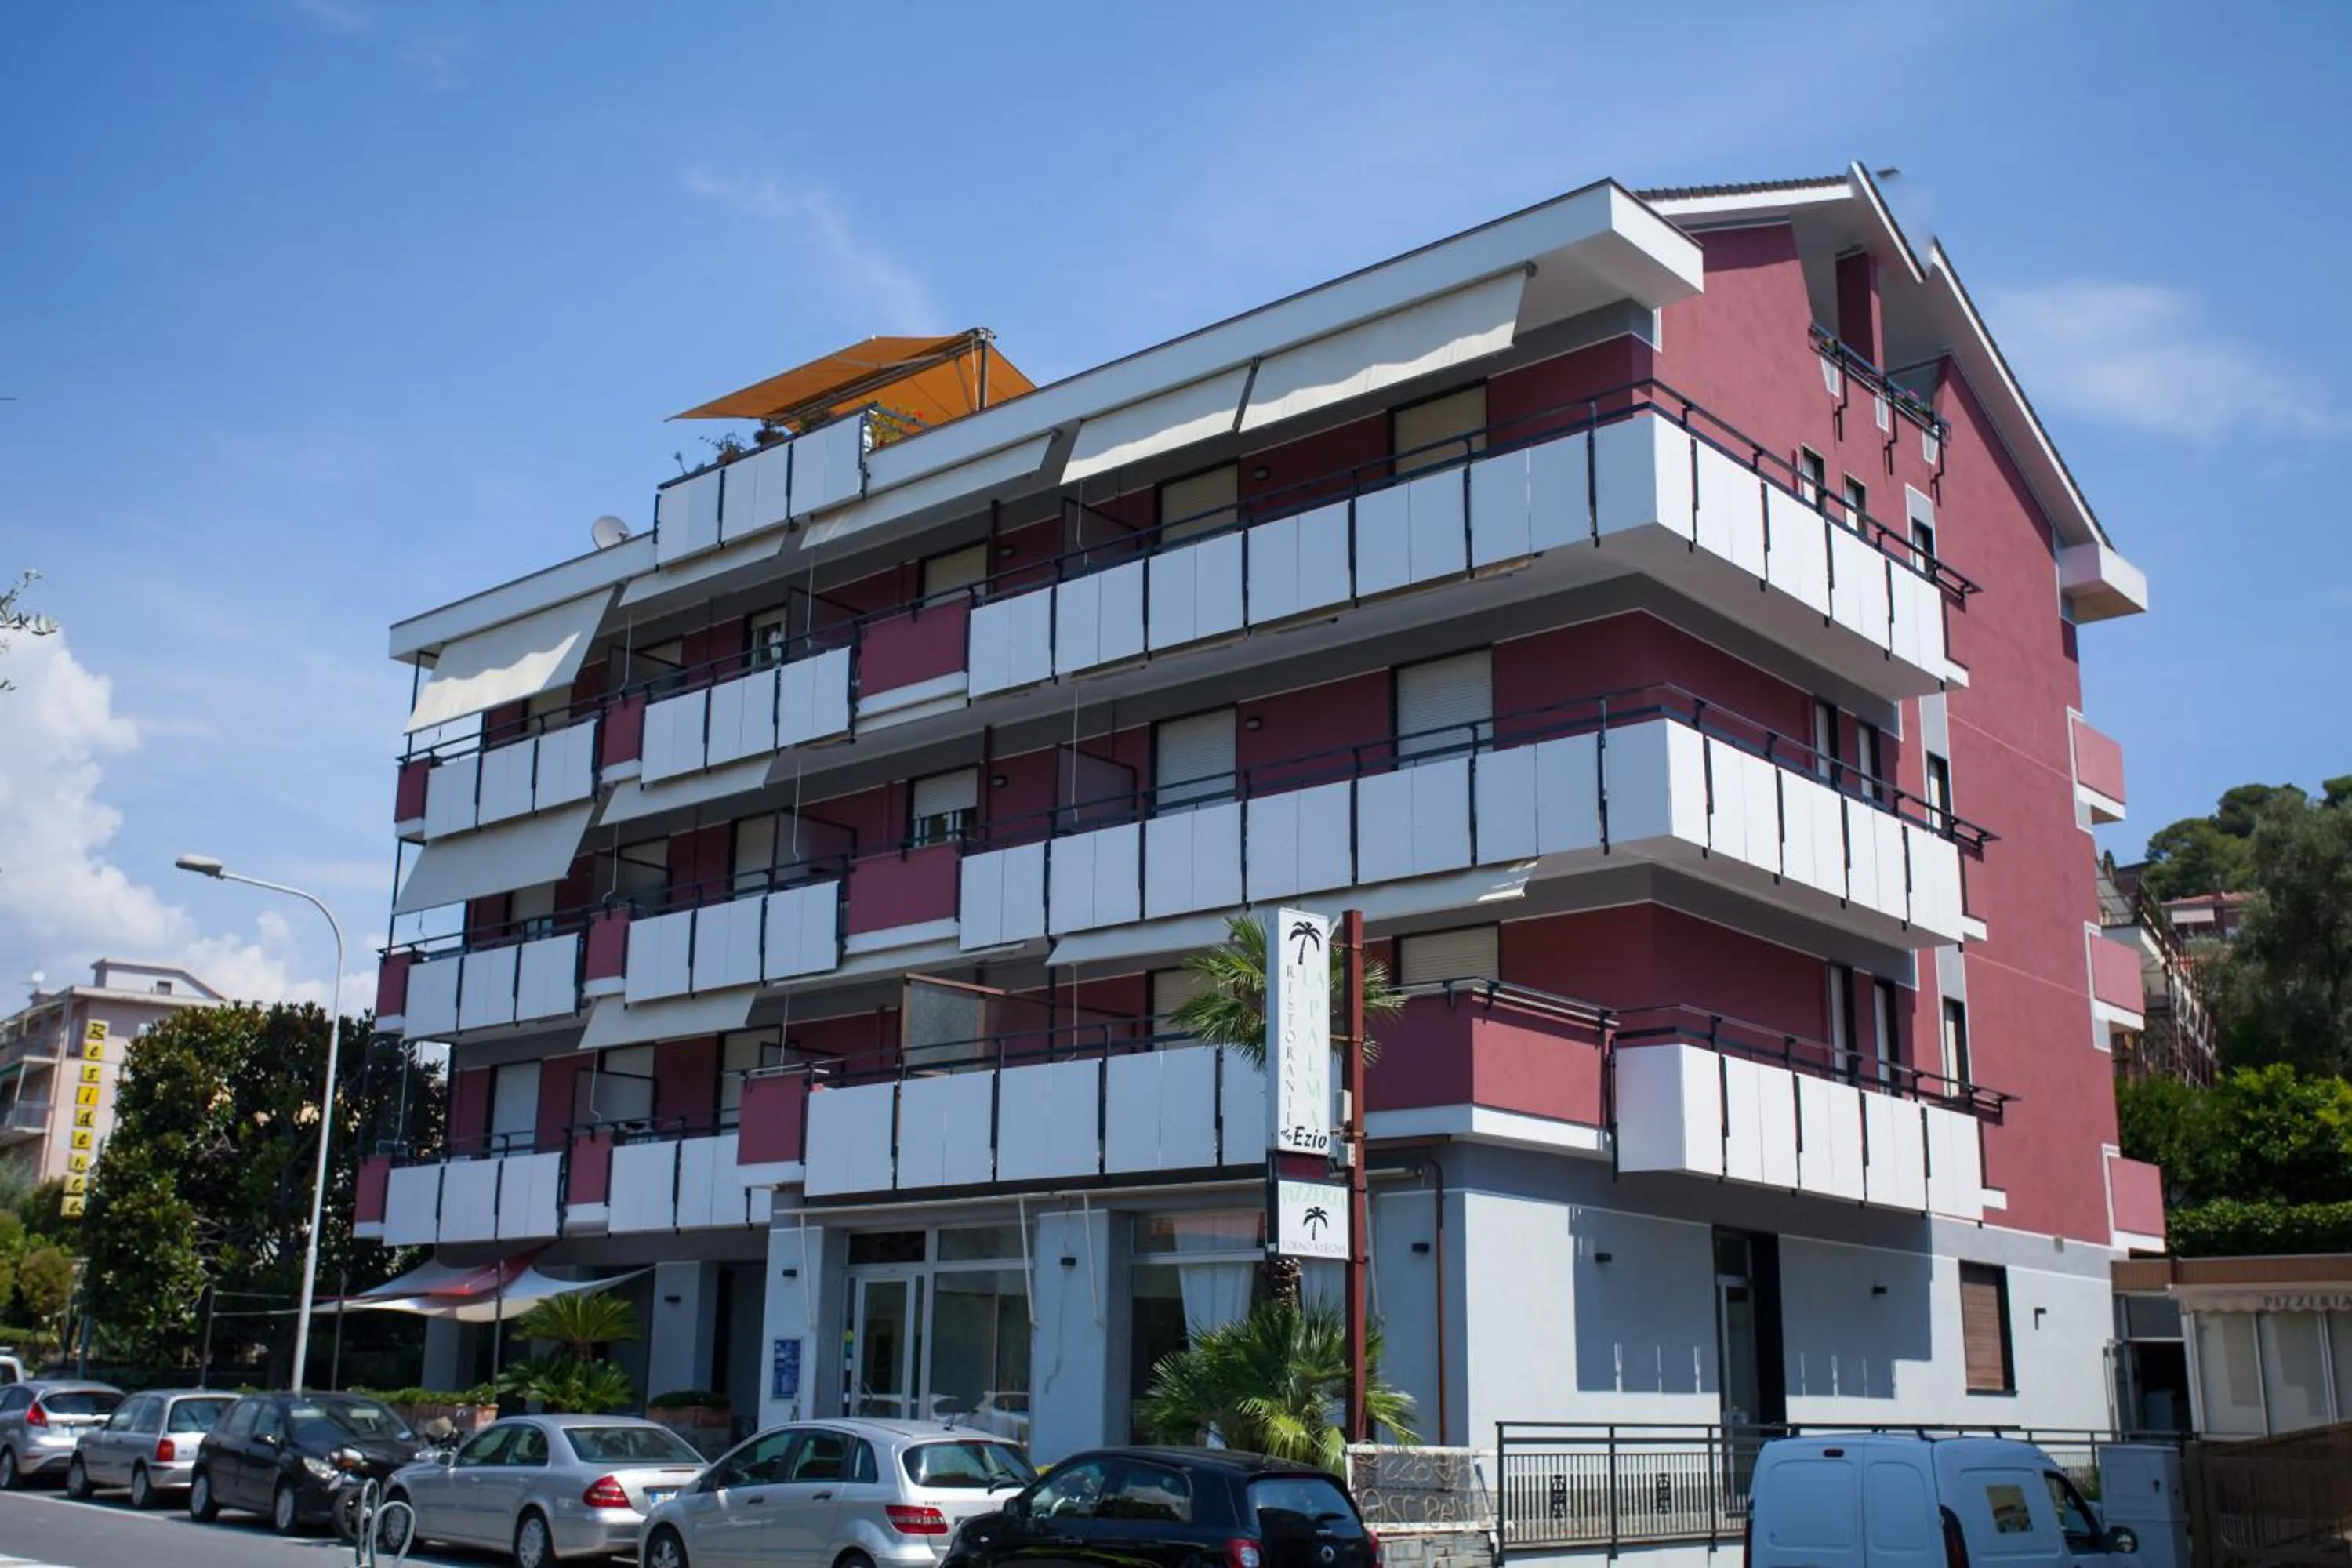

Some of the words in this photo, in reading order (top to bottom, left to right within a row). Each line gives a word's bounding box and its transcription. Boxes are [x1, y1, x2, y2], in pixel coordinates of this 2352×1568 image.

[1303, 966, 1326, 991] LA
[1285, 965, 1296, 1126] RISTORANTE
[1306, 999, 1322, 1127] PALMA
[1280, 1128, 1293, 1142] da
[1293, 1126, 1327, 1149] Ezio
